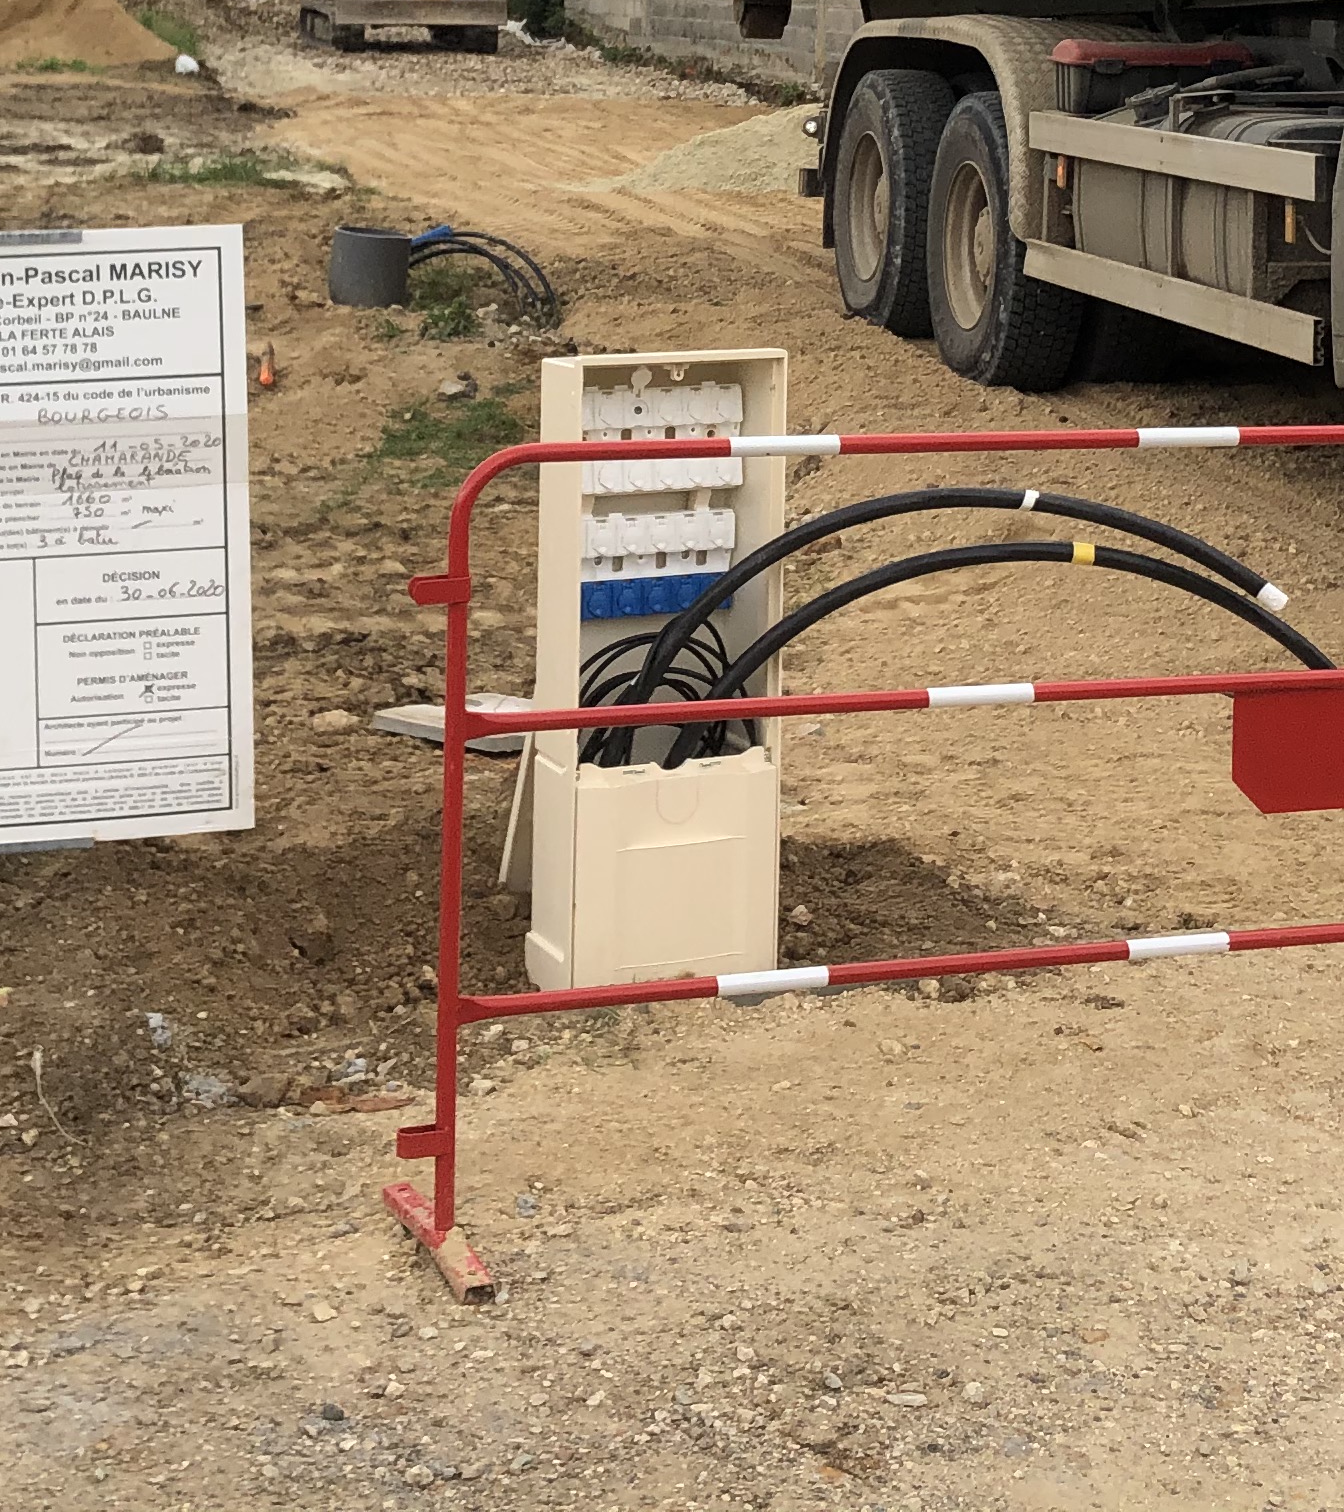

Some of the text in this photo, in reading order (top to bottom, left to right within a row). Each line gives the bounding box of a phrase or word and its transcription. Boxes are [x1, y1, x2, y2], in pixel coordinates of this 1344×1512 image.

[109, 260, 203, 282] MARISY
[82, 287, 159, 307] D.P.L.G.
[55, 312, 75, 324] BP
[121, 307, 182, 322] BAULNE
[21, 328, 68, 341] FERTE
[72, 325, 115, 339] ALAIS
[1, 345, 18, 358] 01
[22, 344, 38, 357] 64
[42, 344, 58, 356] 57
[62, 343, 78, 355] 78
[82, 342, 98, 354] 78
[18, 391, 60, 404] 424-15
[63, 390, 80, 402] du
[83, 389, 115, 401] code
[118, 388, 133, 400] de
[137, 385, 211, 399] l'urbanisme
[38, 404, 169, 425] BOURGEOIS
[102, 570, 160, 583] DÉCISION
[63, 626, 201, 644] DÉCLARATION PRÉALABLE
[77, 676, 116, 686] PERMIS
